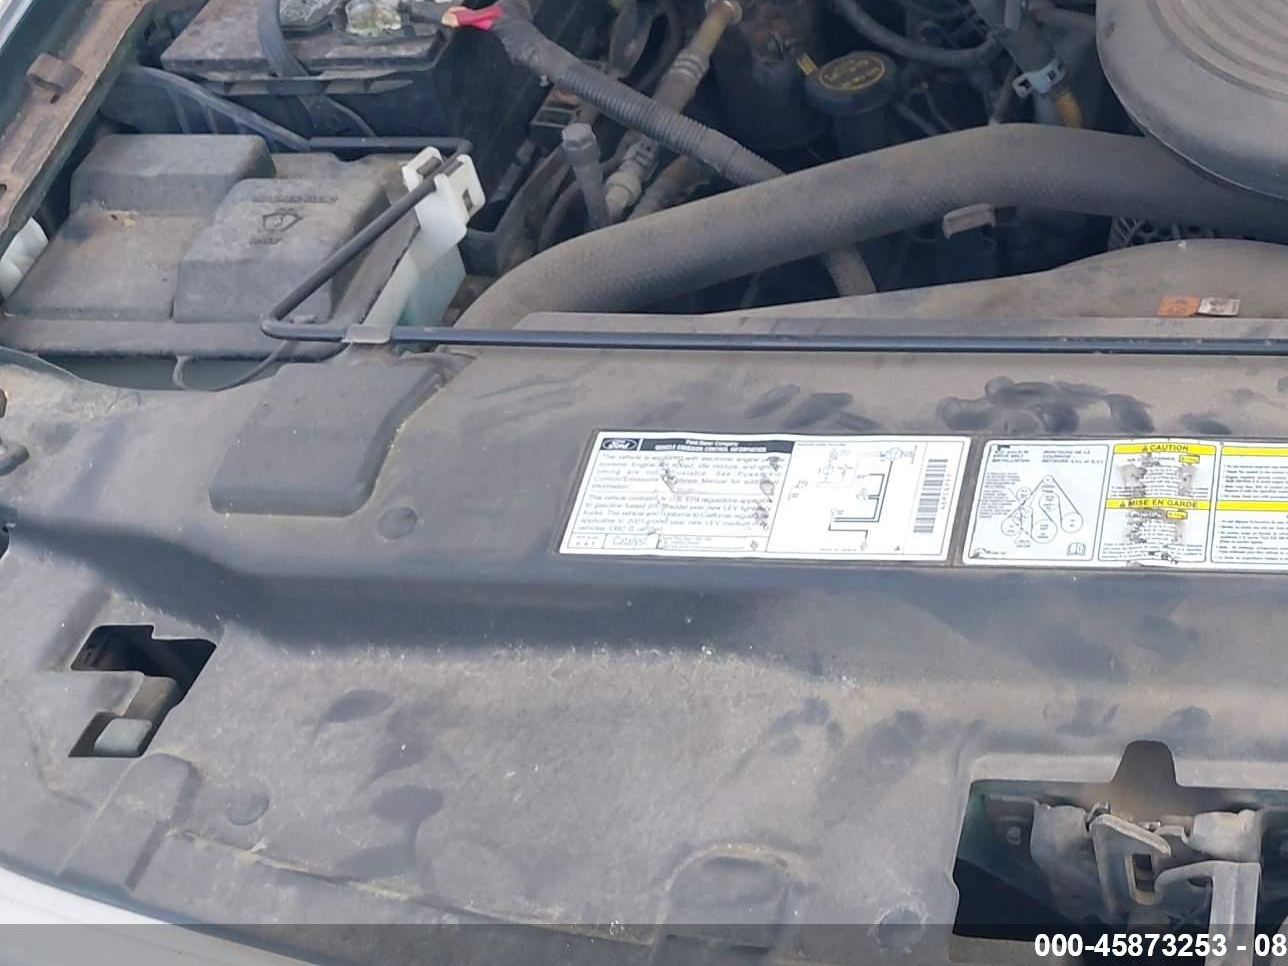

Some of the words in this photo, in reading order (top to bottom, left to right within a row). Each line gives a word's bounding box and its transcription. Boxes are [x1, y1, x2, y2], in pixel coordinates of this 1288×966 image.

[1150, 444, 1189, 452] CAUTION
[1128, 499, 1147, 507] MISE
[1167, 500, 1198, 508] GARDE
